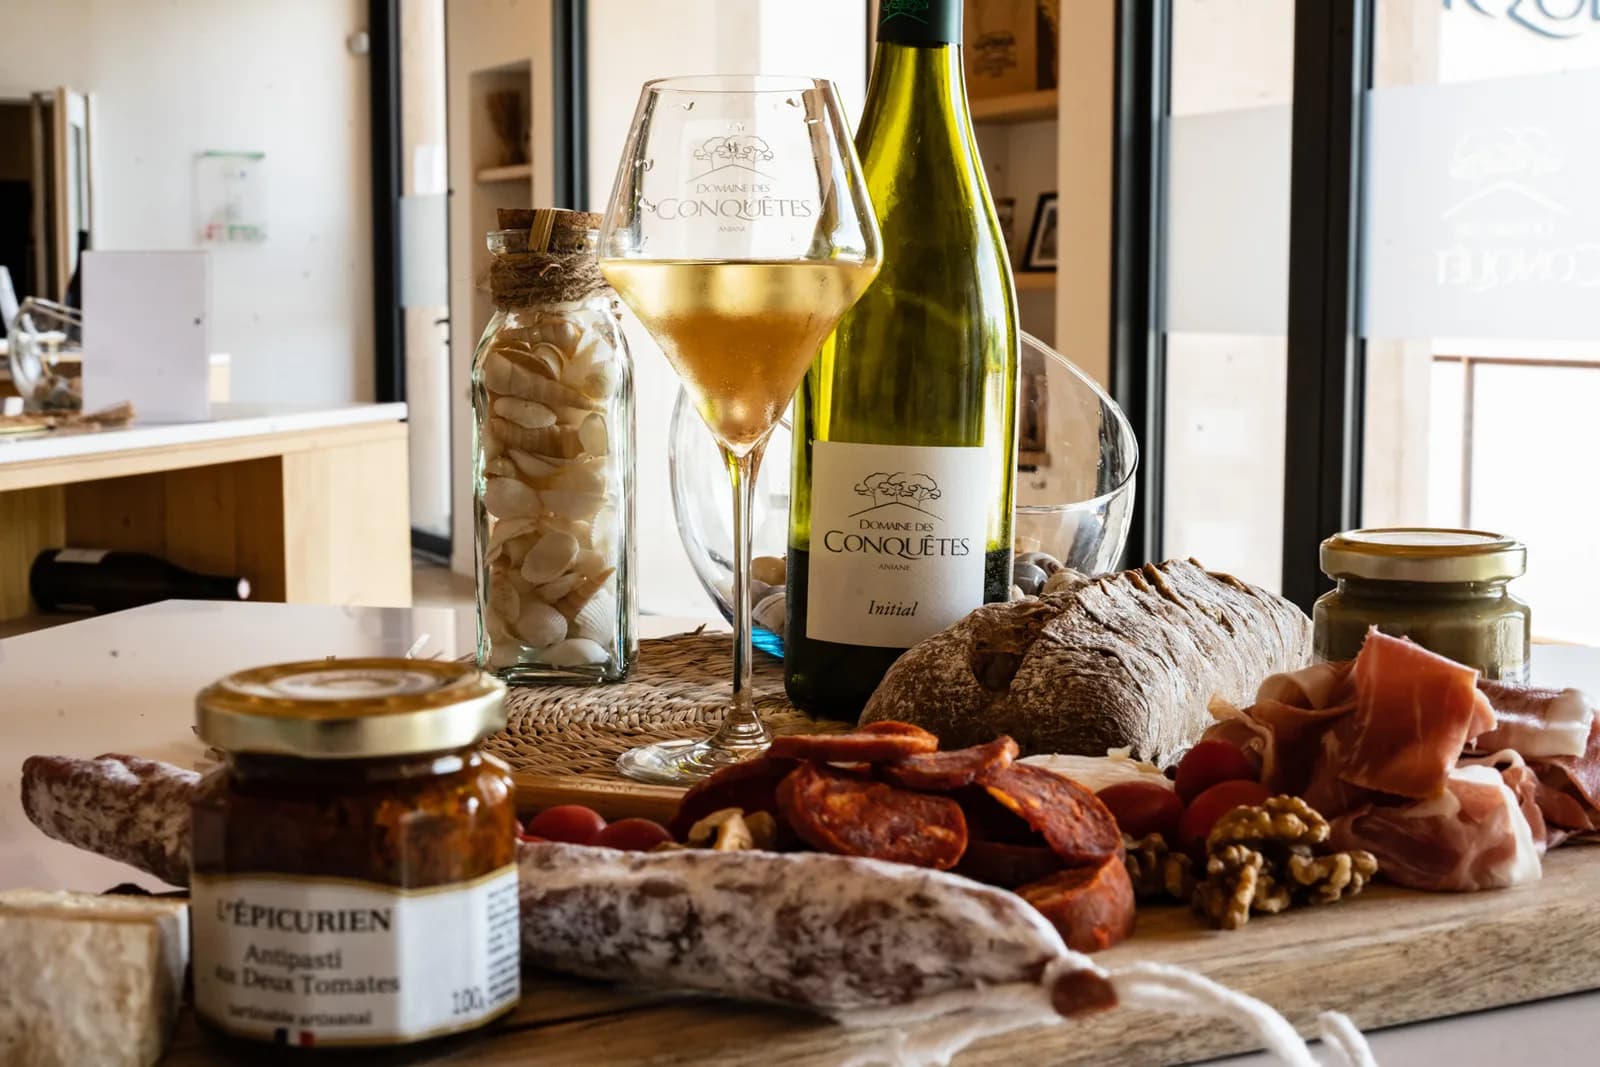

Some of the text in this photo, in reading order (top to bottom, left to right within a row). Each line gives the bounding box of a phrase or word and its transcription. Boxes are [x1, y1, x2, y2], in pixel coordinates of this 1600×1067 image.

[696, 183, 771, 194] DOMAINE DES
[656, 195, 812, 221] CONQUÊTES
[859, 519, 934, 532] DOMAINE DES
[824, 530, 970, 560] CONQUÊTES
[868, 600, 919, 617] Initial
[244, 943, 342, 973] Antipasti
[243, 966, 295, 993] Deux
[301, 974, 401, 996] Tomates
